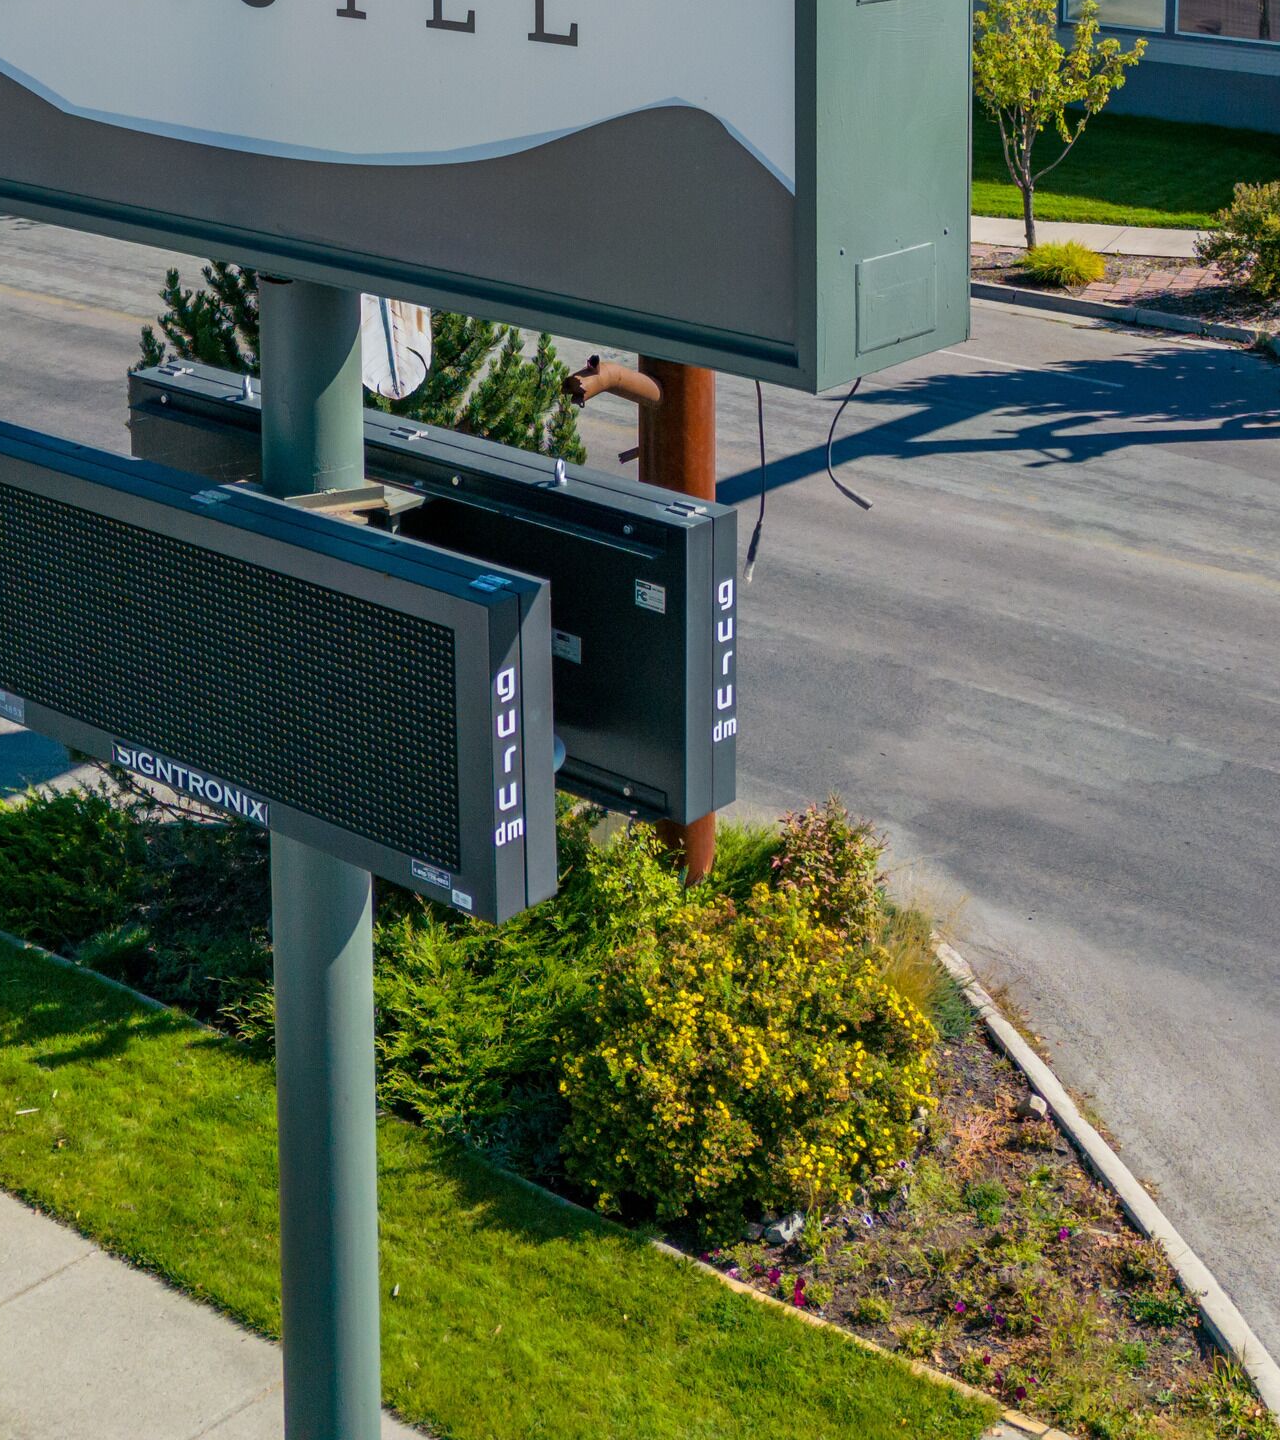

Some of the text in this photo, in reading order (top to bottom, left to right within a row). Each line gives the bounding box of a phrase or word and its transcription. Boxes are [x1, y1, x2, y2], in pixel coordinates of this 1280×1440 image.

[713, 717, 737, 743] dm
[117, 746, 265, 823] SIGNTRONIX
[495, 817, 524, 848] dm
